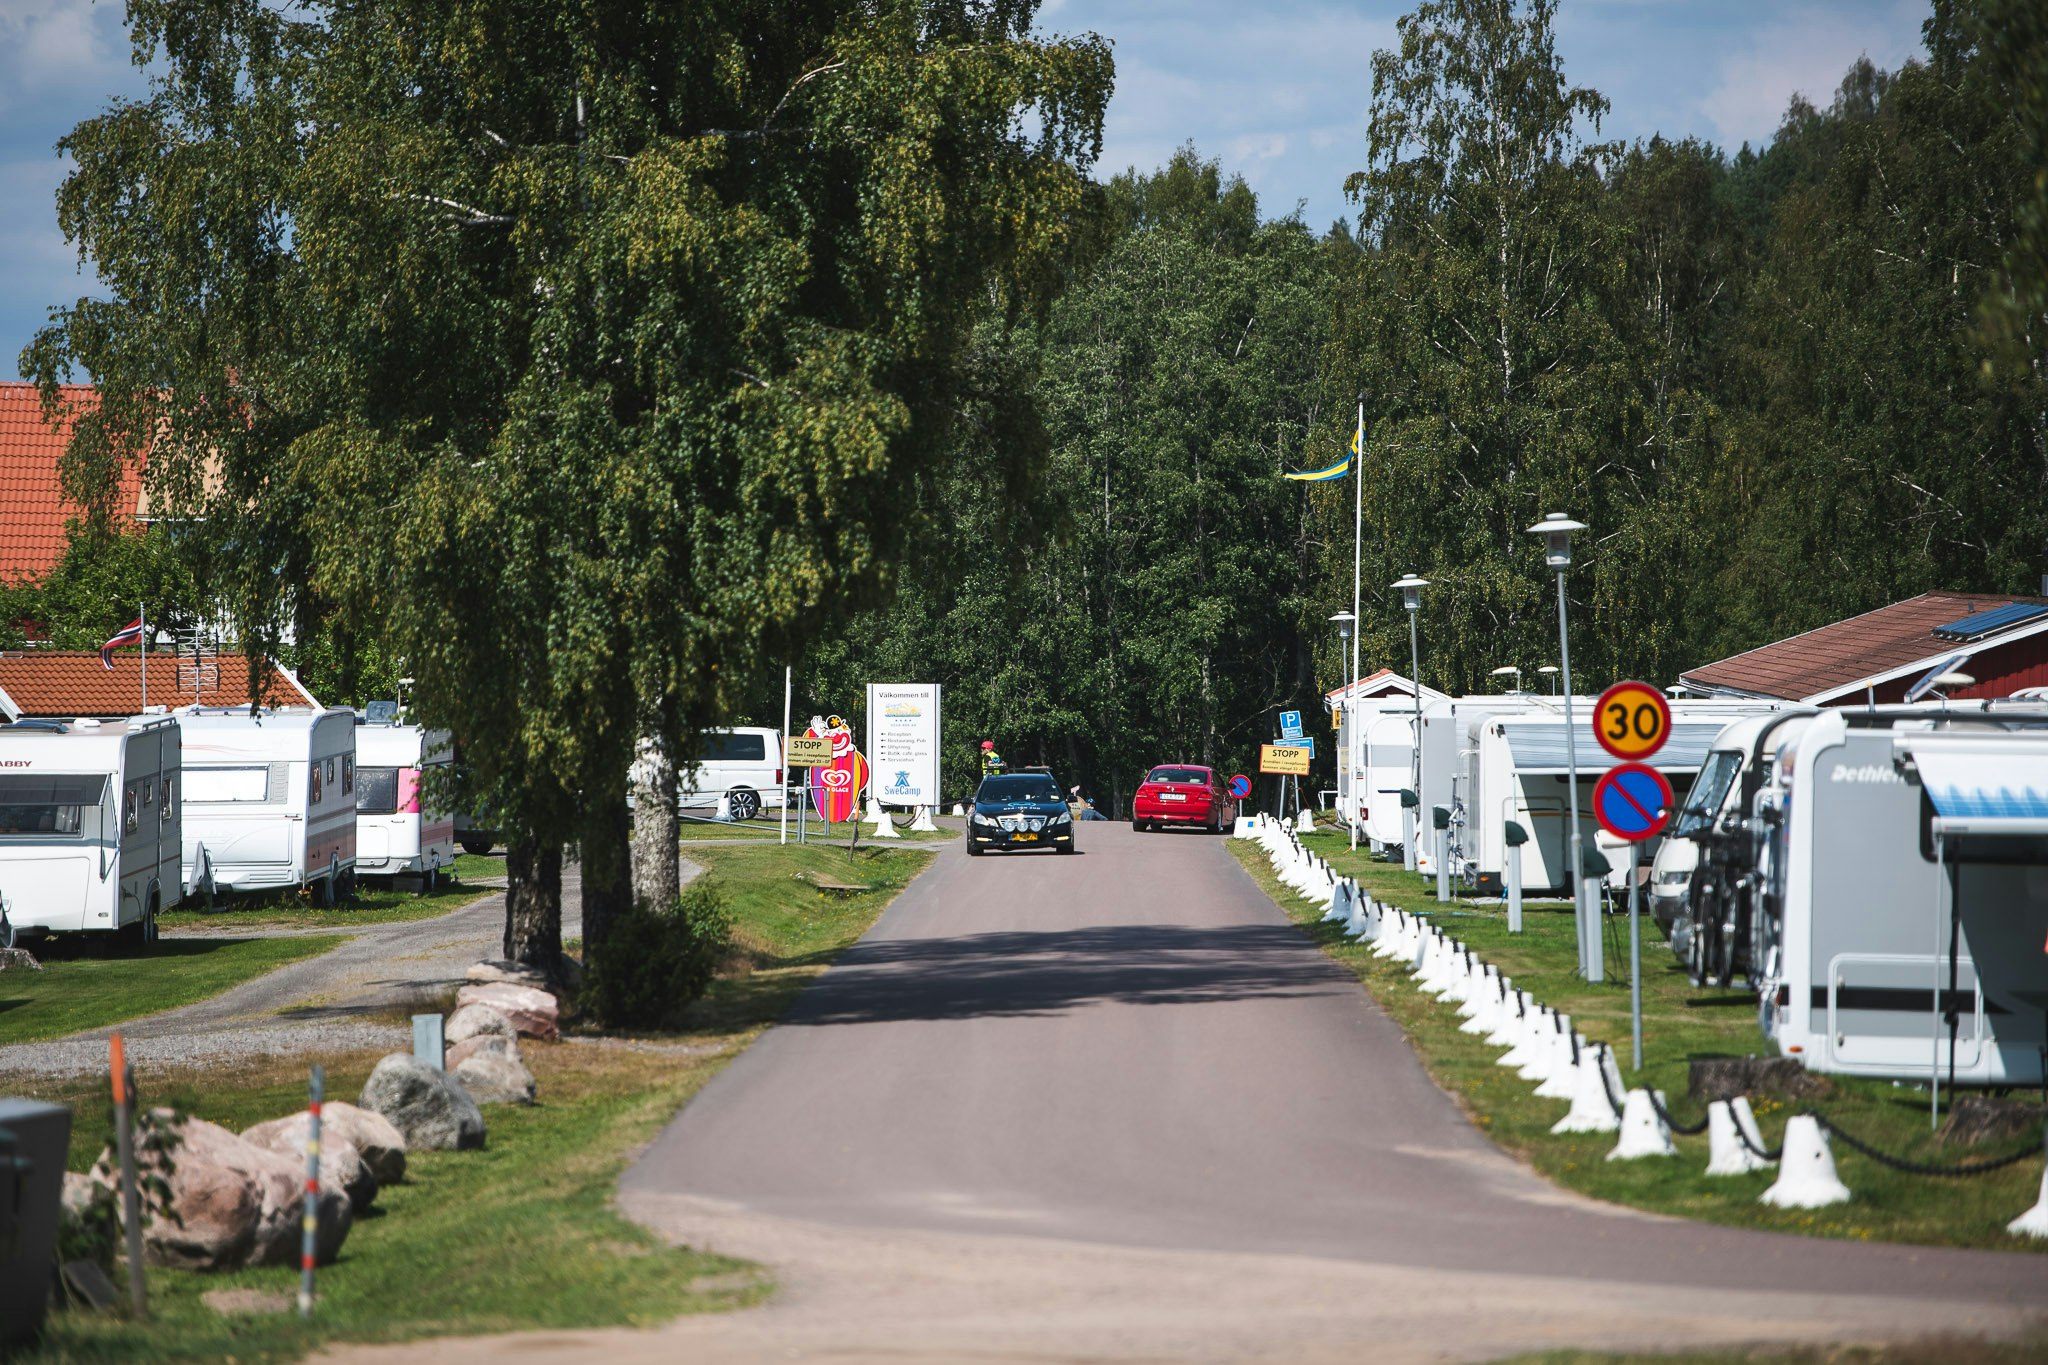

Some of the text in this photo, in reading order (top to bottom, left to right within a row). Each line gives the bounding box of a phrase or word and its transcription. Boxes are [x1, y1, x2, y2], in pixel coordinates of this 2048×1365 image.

[1286, 714, 1296, 727] P
[1607, 703, 1660, 741] 30
[794, 740, 822, 750] STOPP
[1272, 749, 1299, 758] STOPP
[884, 785, 921, 797] SweCamp
